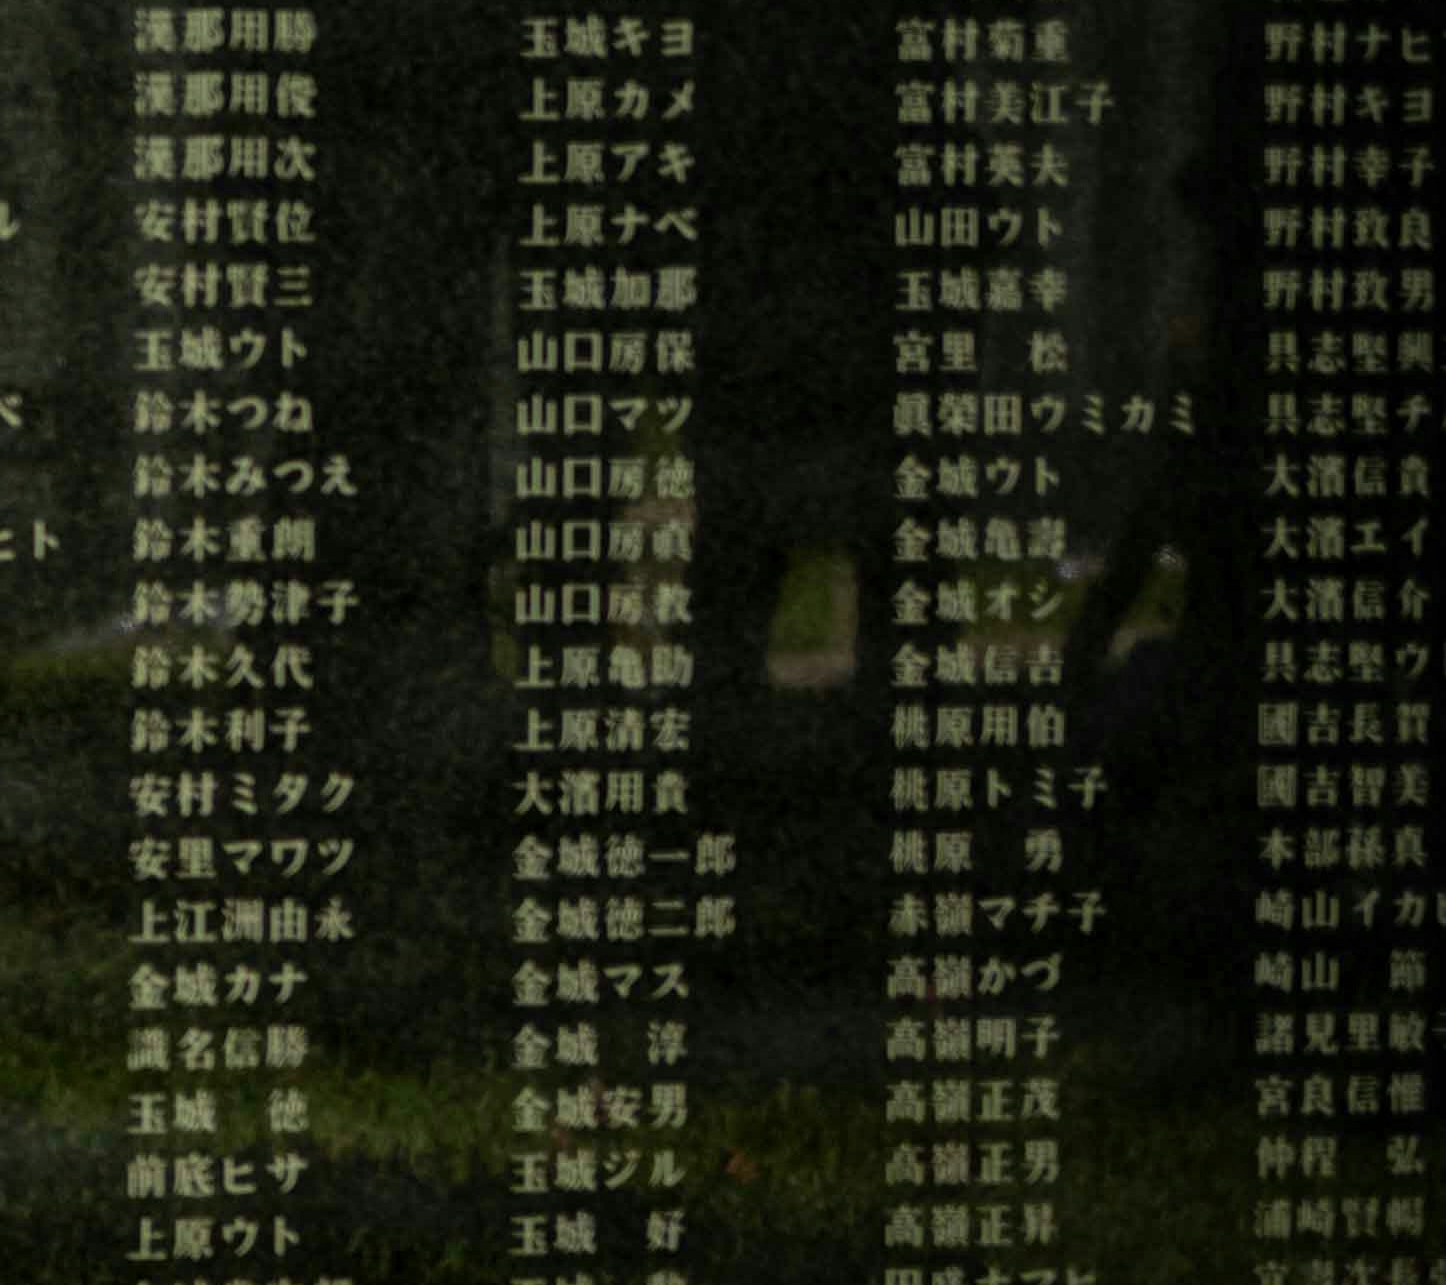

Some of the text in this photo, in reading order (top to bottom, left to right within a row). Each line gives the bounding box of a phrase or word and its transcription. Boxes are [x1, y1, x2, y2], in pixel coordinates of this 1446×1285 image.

[521, 15, 695, 59] 玉城キヨ
[519, 77, 696, 121] 上原カメ
[1263, 83, 1433, 124] 野村キヨ
[518, 140, 696, 185] 上原アキ
[1263, 145, 1433, 187] 野村幸子
[894, 207, 1063, 247] 山田ウト
[133, 263, 313, 307] 安村賢三
[520, 265, 698, 311] 玉城加那
[135, 327, 308, 372] 玉城ウト
[133, 390, 313, 433] 鈴木つね
[515, 394, 693, 436] 山口マツ
[133, 453, 359, 497] 鈴木みつえ
[896, 455, 1060, 500] 金城ウト
[895, 580, 1063, 625] 金城オシ
[132, 645, 314, 689] 鈴木久代
[894, 639, 1063, 687] 金城信吉
[130, 707, 311, 752] 鈴木利子
[890, 764, 1109, 812] 桃原トミ子
[130, 962, 308, 1010] 金城カナ
[513, 960, 690, 1006] 金城マス
[512, 1082, 688, 1132] 金城安男
[512, 1149, 687, 1194] 玉城ジル
[127, 1216, 300, 1261] 上原ウト
